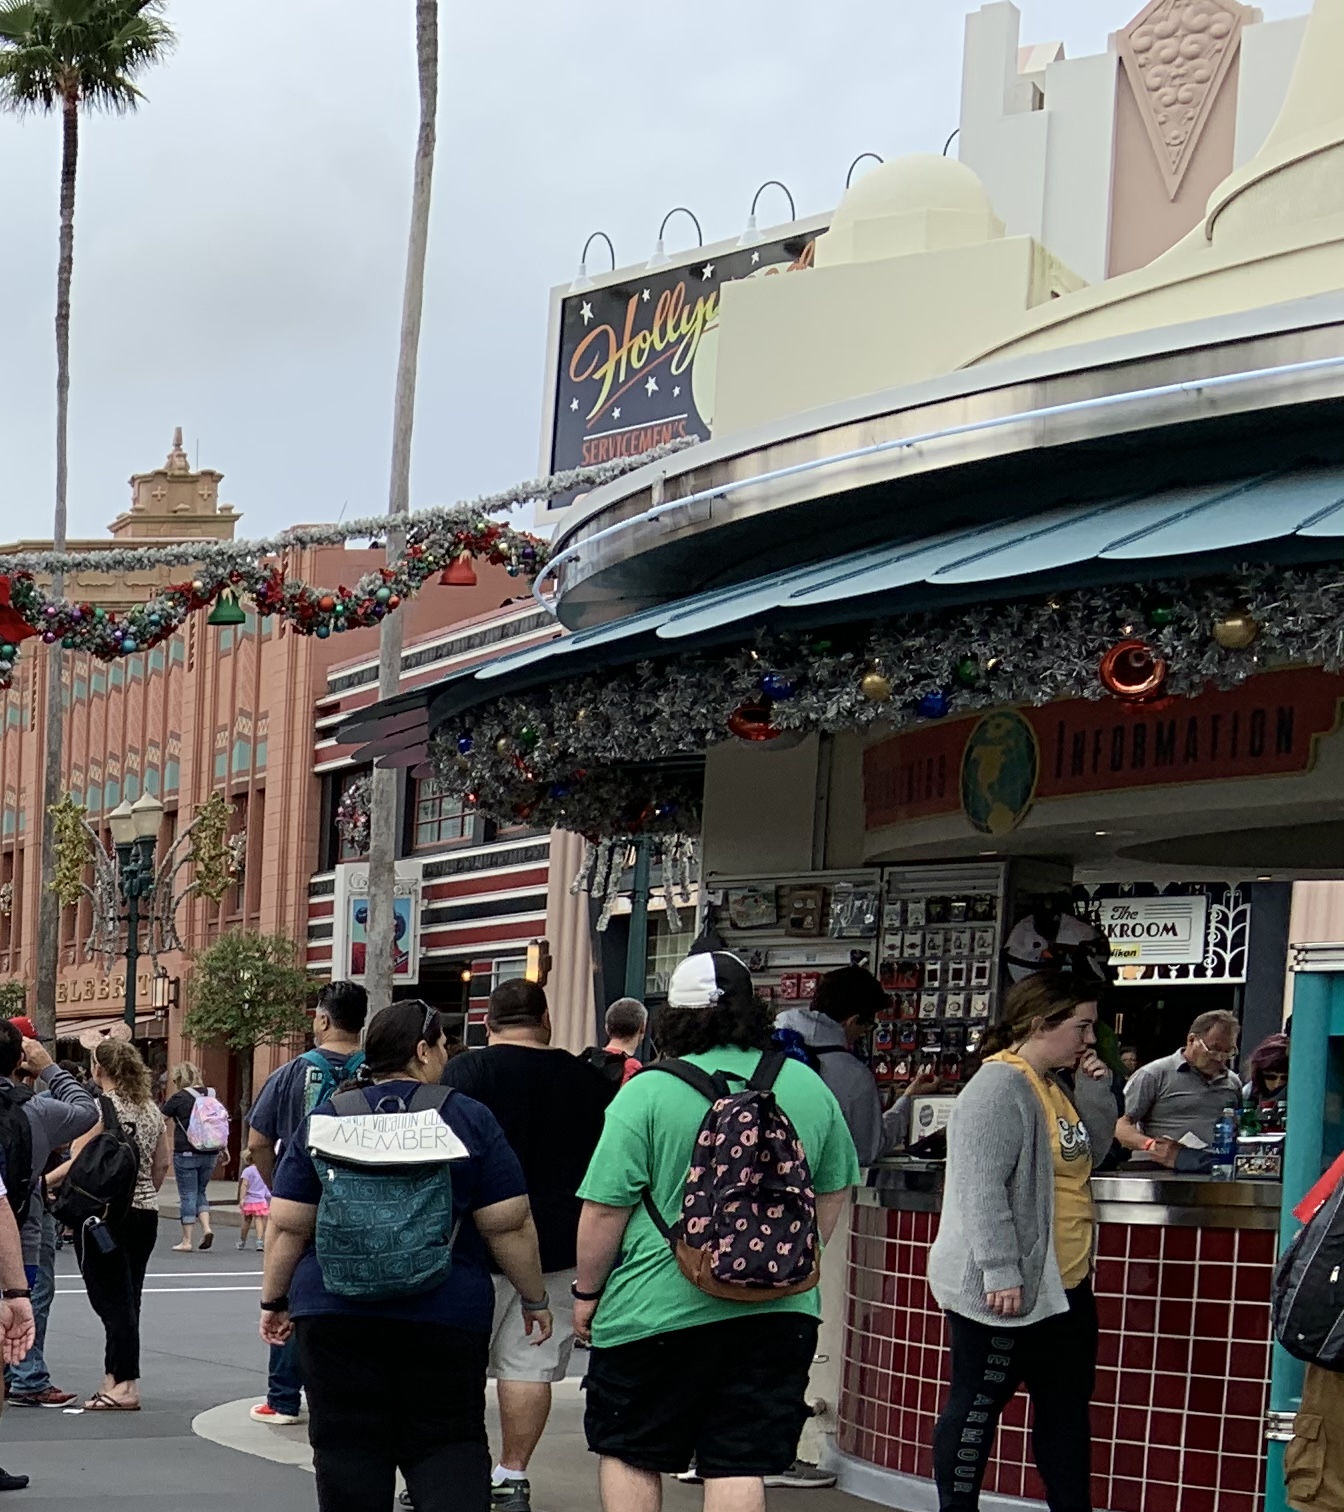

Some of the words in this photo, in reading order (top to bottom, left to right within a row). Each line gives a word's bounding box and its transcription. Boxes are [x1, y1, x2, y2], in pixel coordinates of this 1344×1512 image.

[1056, 705, 1295, 779] INFORMATION
[1111, 906, 1139, 920] The
[1100, 922, 1178, 938] RKROOM
[57, 973, 151, 1003] ELEBRT
[333, 1124, 448, 1150] MEMBER
[984, 1336, 1015, 1384] DER
